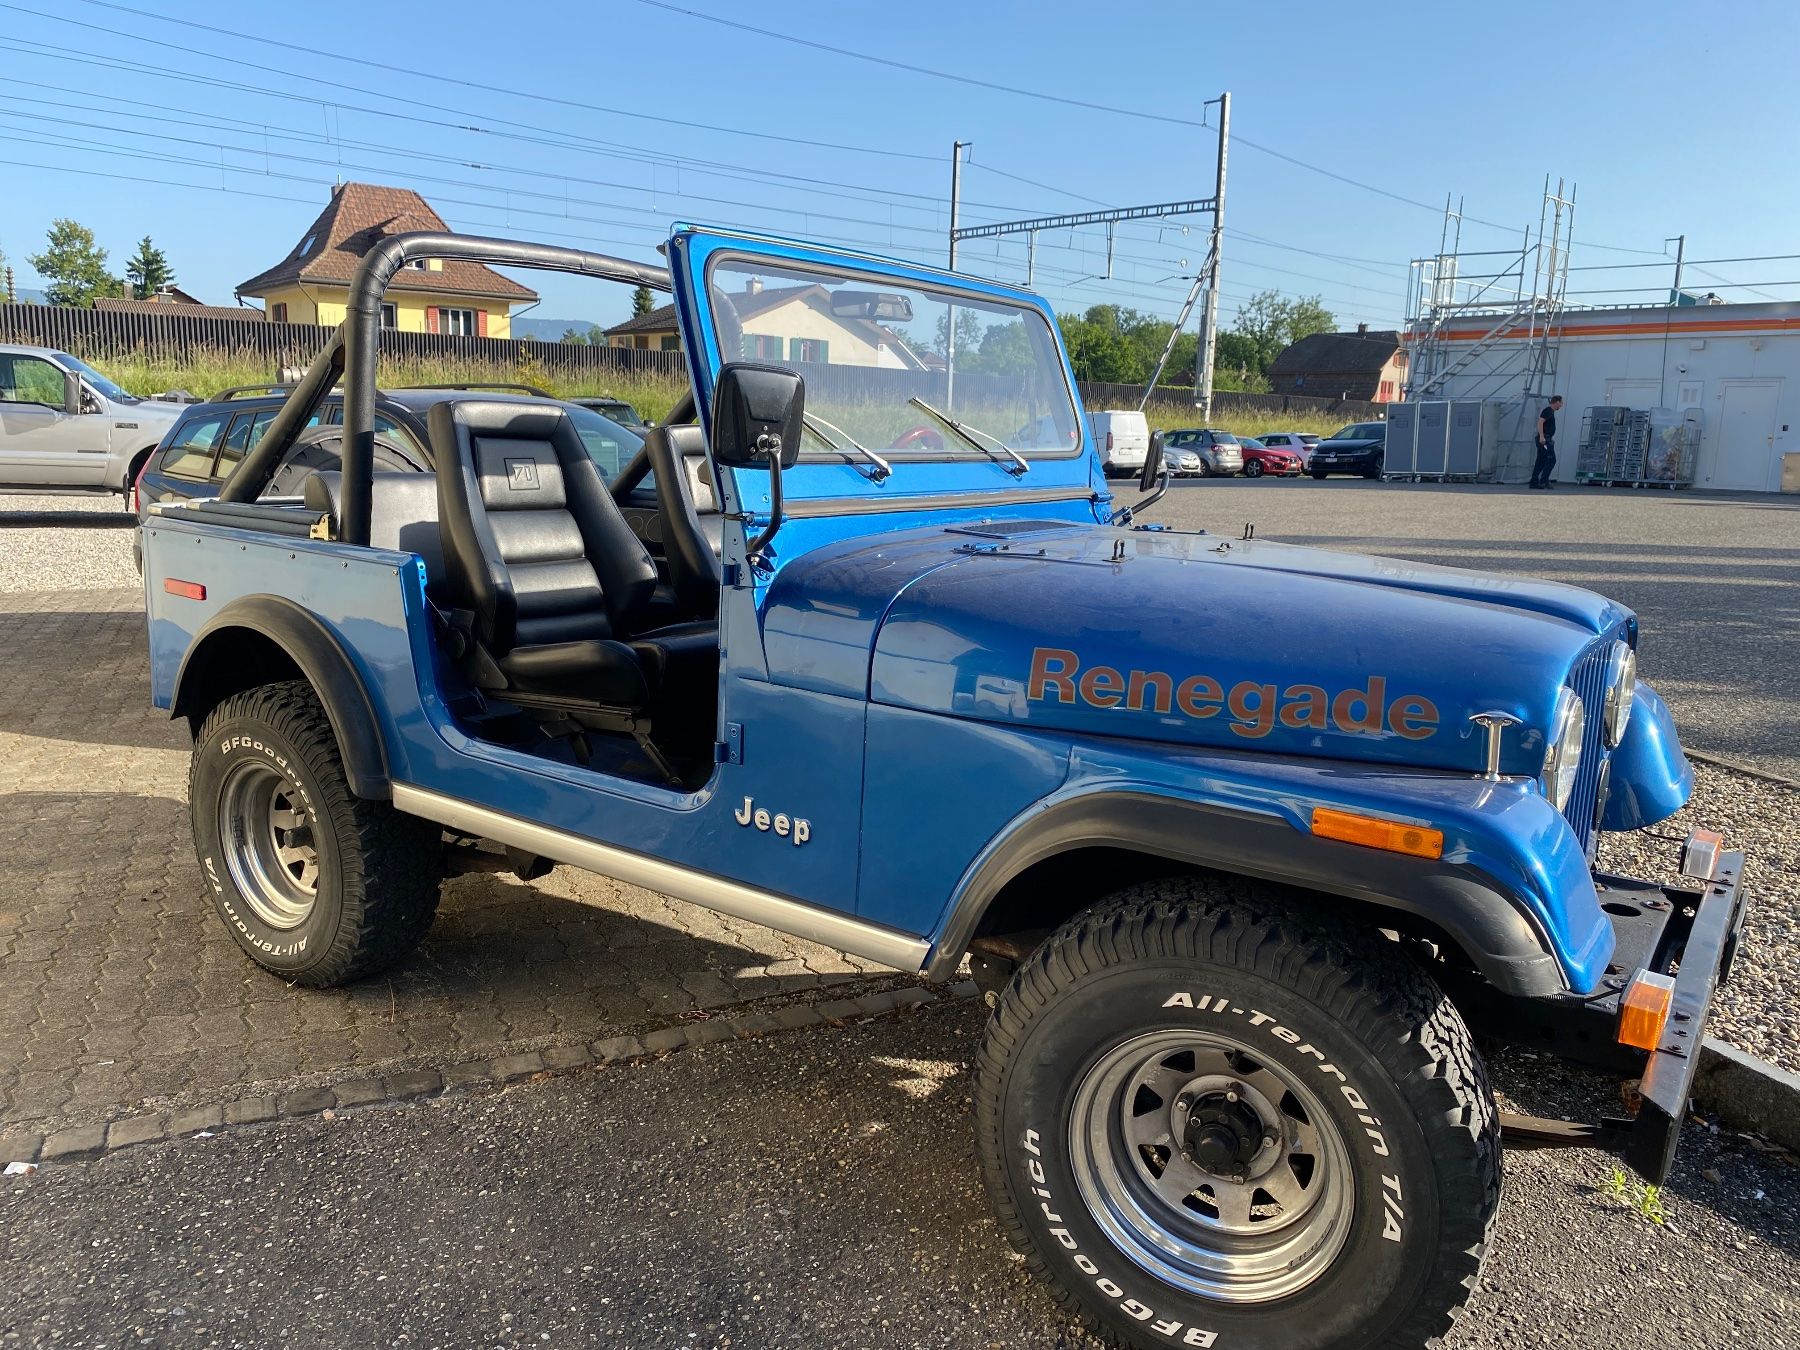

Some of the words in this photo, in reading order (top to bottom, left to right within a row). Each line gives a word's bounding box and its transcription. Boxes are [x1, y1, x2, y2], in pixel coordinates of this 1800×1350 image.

[1028, 647, 1440, 740] Renegade
[221, 736, 318, 823] BFGoodrich
[734, 796, 812, 845] Jeep
[204, 857, 223, 896] T/A
[223, 901, 308, 956] All-Terrain
[1162, 992, 1389, 1156] All-Terrain
[1381, 1174, 1404, 1243] T/A
[1023, 1128, 1219, 1349] BFGoodrich
